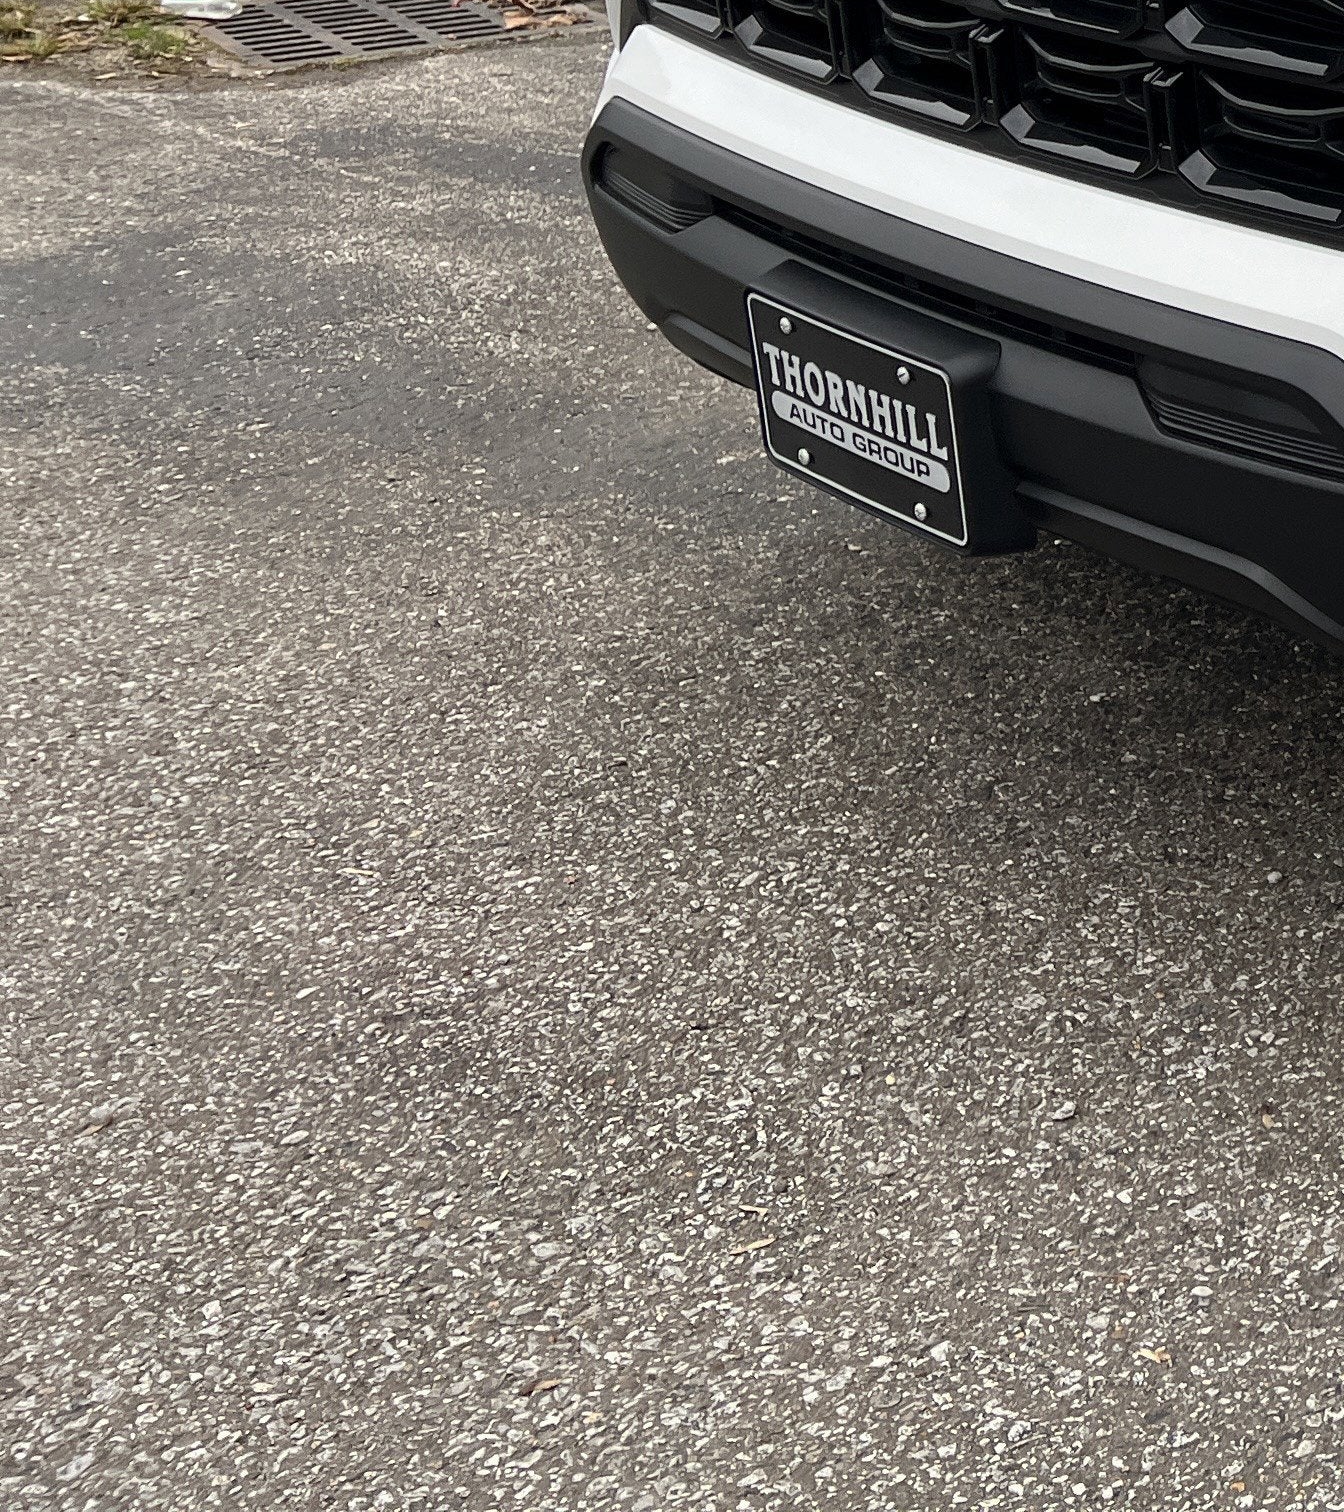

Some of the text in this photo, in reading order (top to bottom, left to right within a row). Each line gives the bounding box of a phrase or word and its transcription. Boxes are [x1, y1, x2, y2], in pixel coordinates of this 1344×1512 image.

[763, 342, 949, 461] THORNHILL
[790, 403, 930, 478] AUTO GROUP
